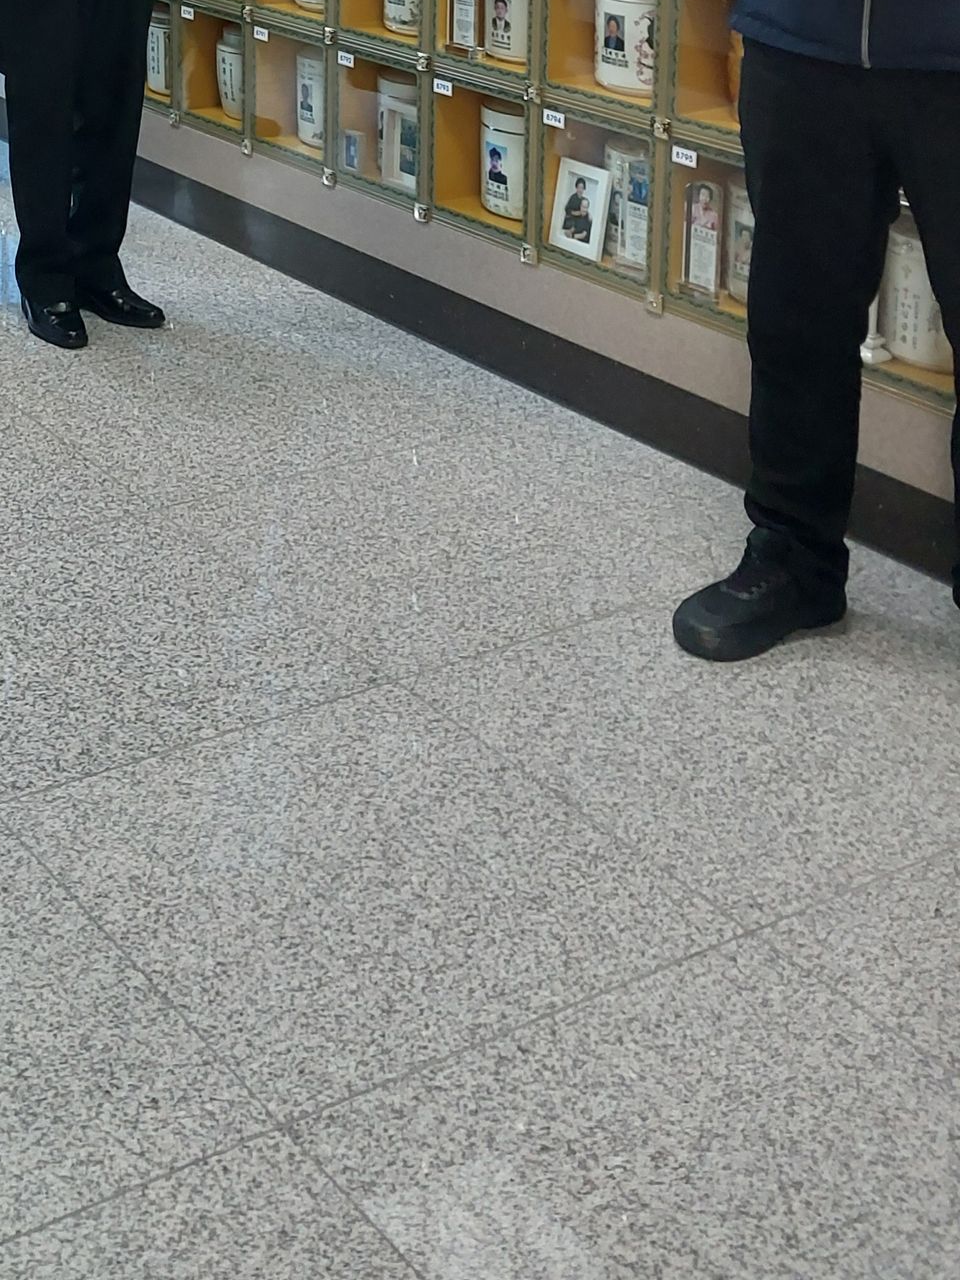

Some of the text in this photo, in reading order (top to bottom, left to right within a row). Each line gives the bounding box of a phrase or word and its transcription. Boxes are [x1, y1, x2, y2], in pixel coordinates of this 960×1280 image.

[340, 55, 352, 64] 8792
[436, 82, 450, 92] 8793
[546, 113, 562, 124] 8794
[675, 151, 694, 163] 8795
